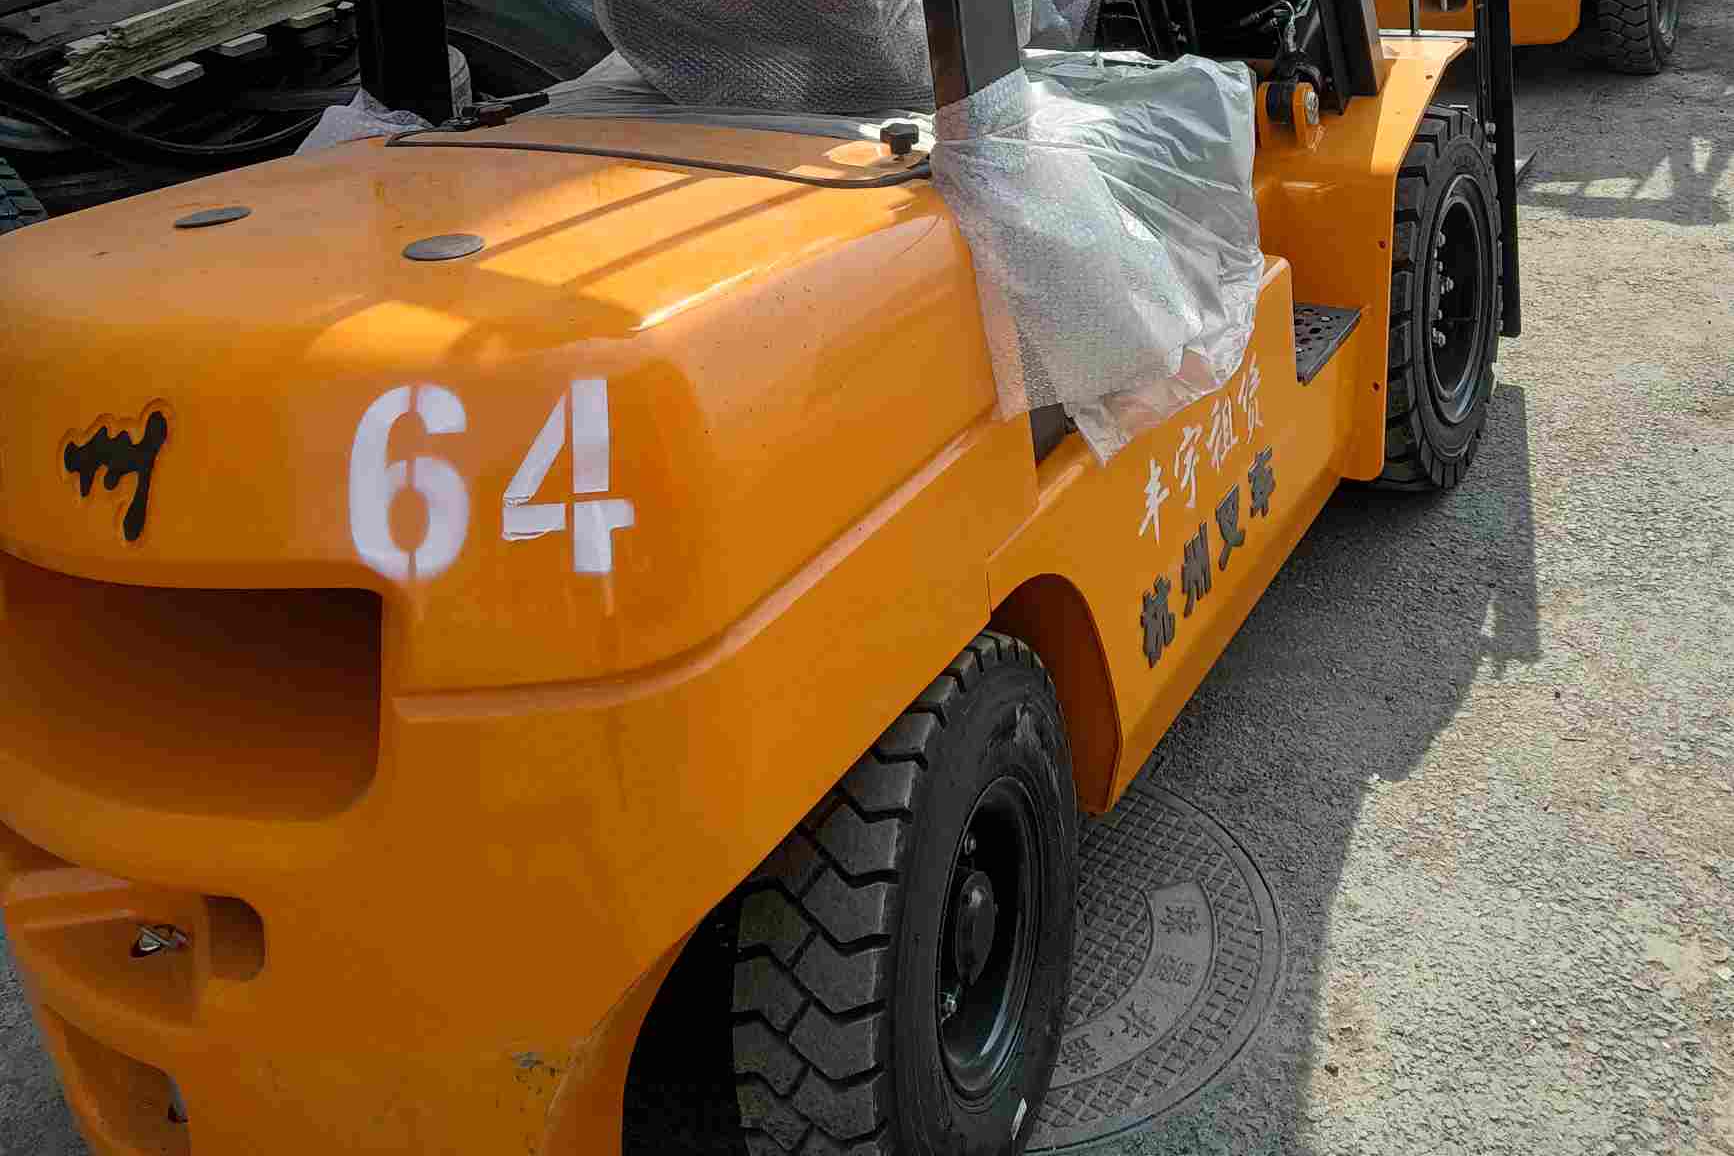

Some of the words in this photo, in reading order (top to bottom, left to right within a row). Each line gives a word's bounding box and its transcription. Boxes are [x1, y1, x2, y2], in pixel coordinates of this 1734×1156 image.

[348, 379, 635, 582] 64
[1140, 443, 1276, 669] 杭州叉车
